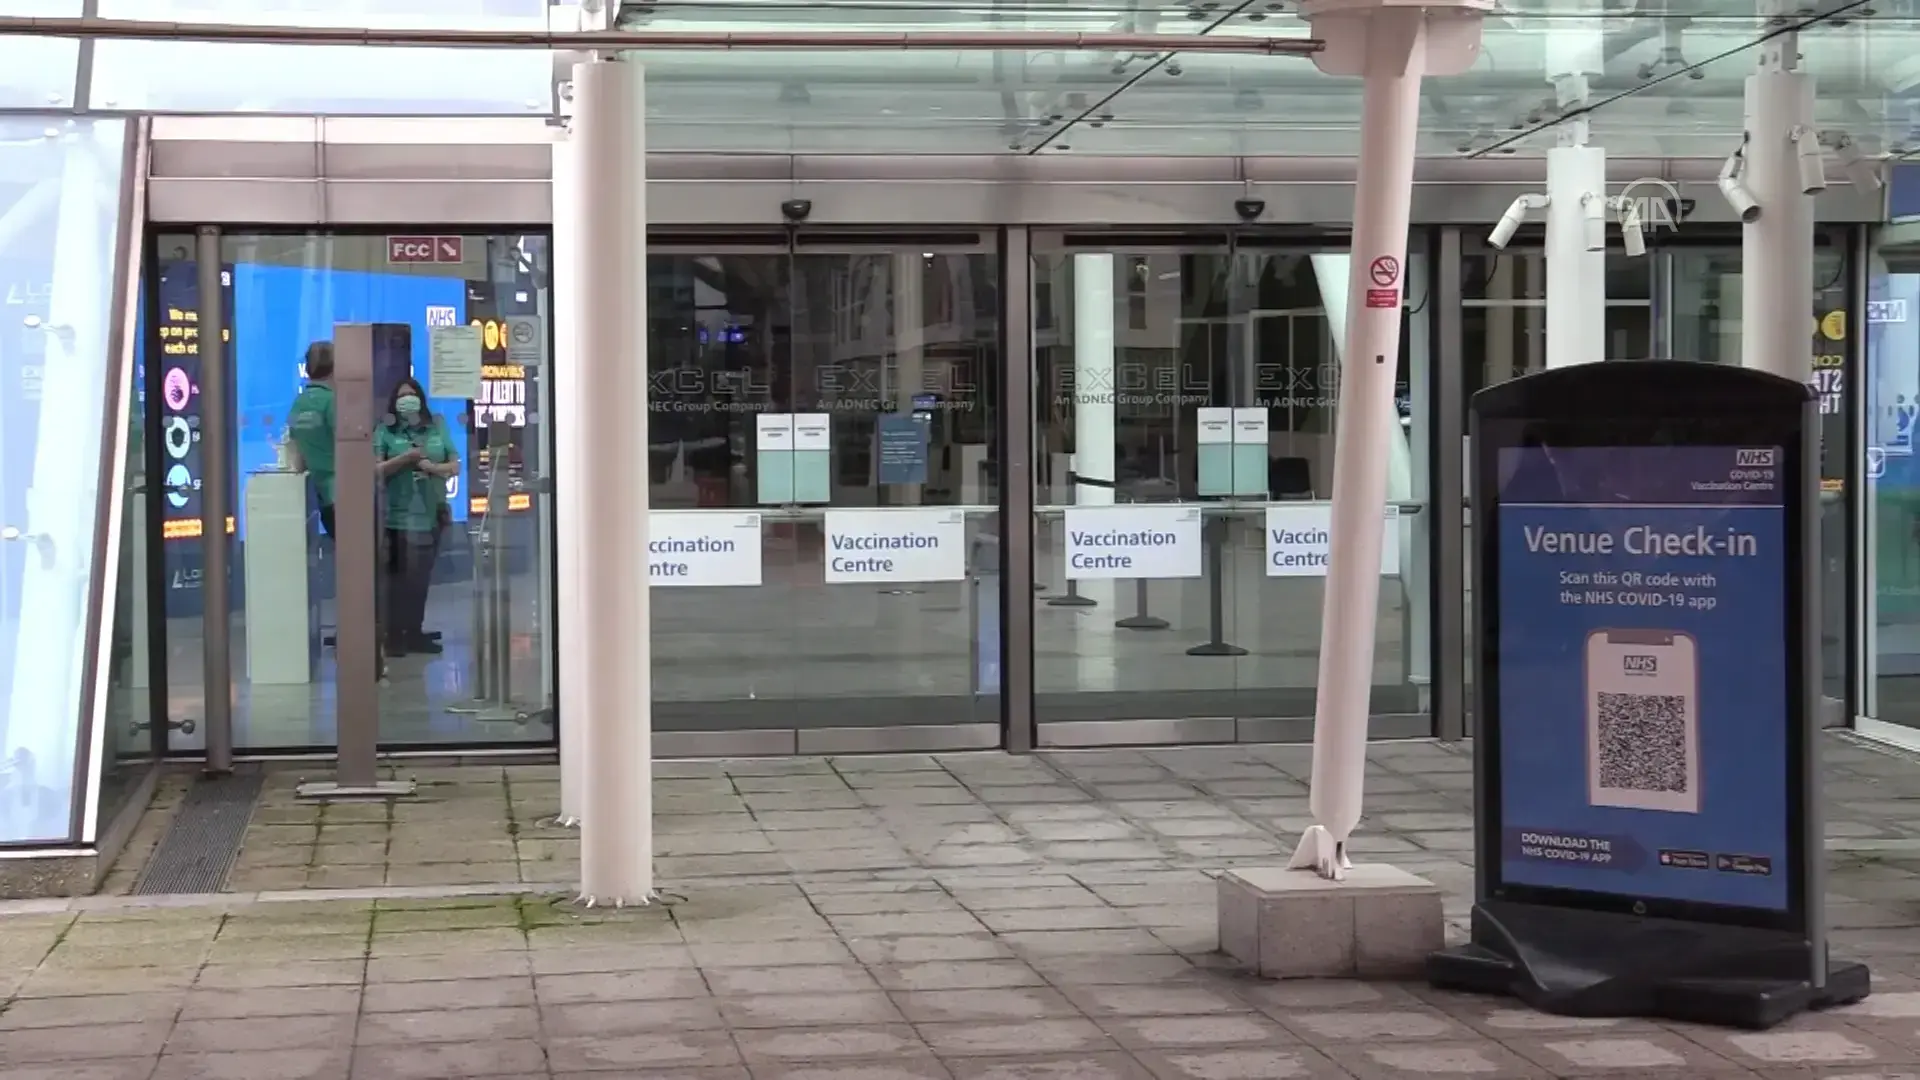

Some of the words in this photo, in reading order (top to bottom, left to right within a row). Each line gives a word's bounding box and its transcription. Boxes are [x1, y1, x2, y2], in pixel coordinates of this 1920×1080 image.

[393, 243, 430, 258] FCC
[429, 309, 453, 327] NHS
[673, 401, 711, 414] Group
[713, 401, 770, 414] Company
[816, 400, 833, 409] An
[835, 399, 879, 410] ADNEC
[1055, 395, 1070, 405] An
[1073, 393, 1115, 404] ADNEC
[1117, 393, 1154, 407] Group
[1155, 393, 1208, 406] Company
[1255, 397, 1271, 407] An
[1273, 397, 1315, 408] ADNEC
[1738, 450, 1772, 465] NHS
[1730, 470, 1774, 480] COVID-19
[1691, 481, 1742, 491] Vaccination
[1744, 481, 1774, 491] Centre
[831, 532, 938, 550] Vaccination
[1071, 529, 1176, 546] Vaccination
[1524, 525, 1614, 553] Venue
[1623, 525, 1758, 556] Check-in
[832, 557, 894, 573] Centre
[1071, 553, 1132, 568] Centre
[1559, 571, 1589, 585] Scan
[1593, 571, 1618, 585] this
[1622, 572, 1642, 587] QR
[1646, 571, 1680, 587] code
[1682, 573, 1717, 588] with
[1560, 590, 1582, 605] the
[1585, 591, 1613, 605] NHS
[1617, 592, 1685, 607] COVID-19
[1688, 595, 1717, 610] app
[1624, 656, 1656, 671] NHS
[1521, 832, 1588, 849] DOWNLOAD
[1589, 839, 1611, 851] THE
[1521, 846, 1543, 857] NHS
[1544, 849, 1590, 861] COVID-19
[1592, 852, 1612, 863] APP
